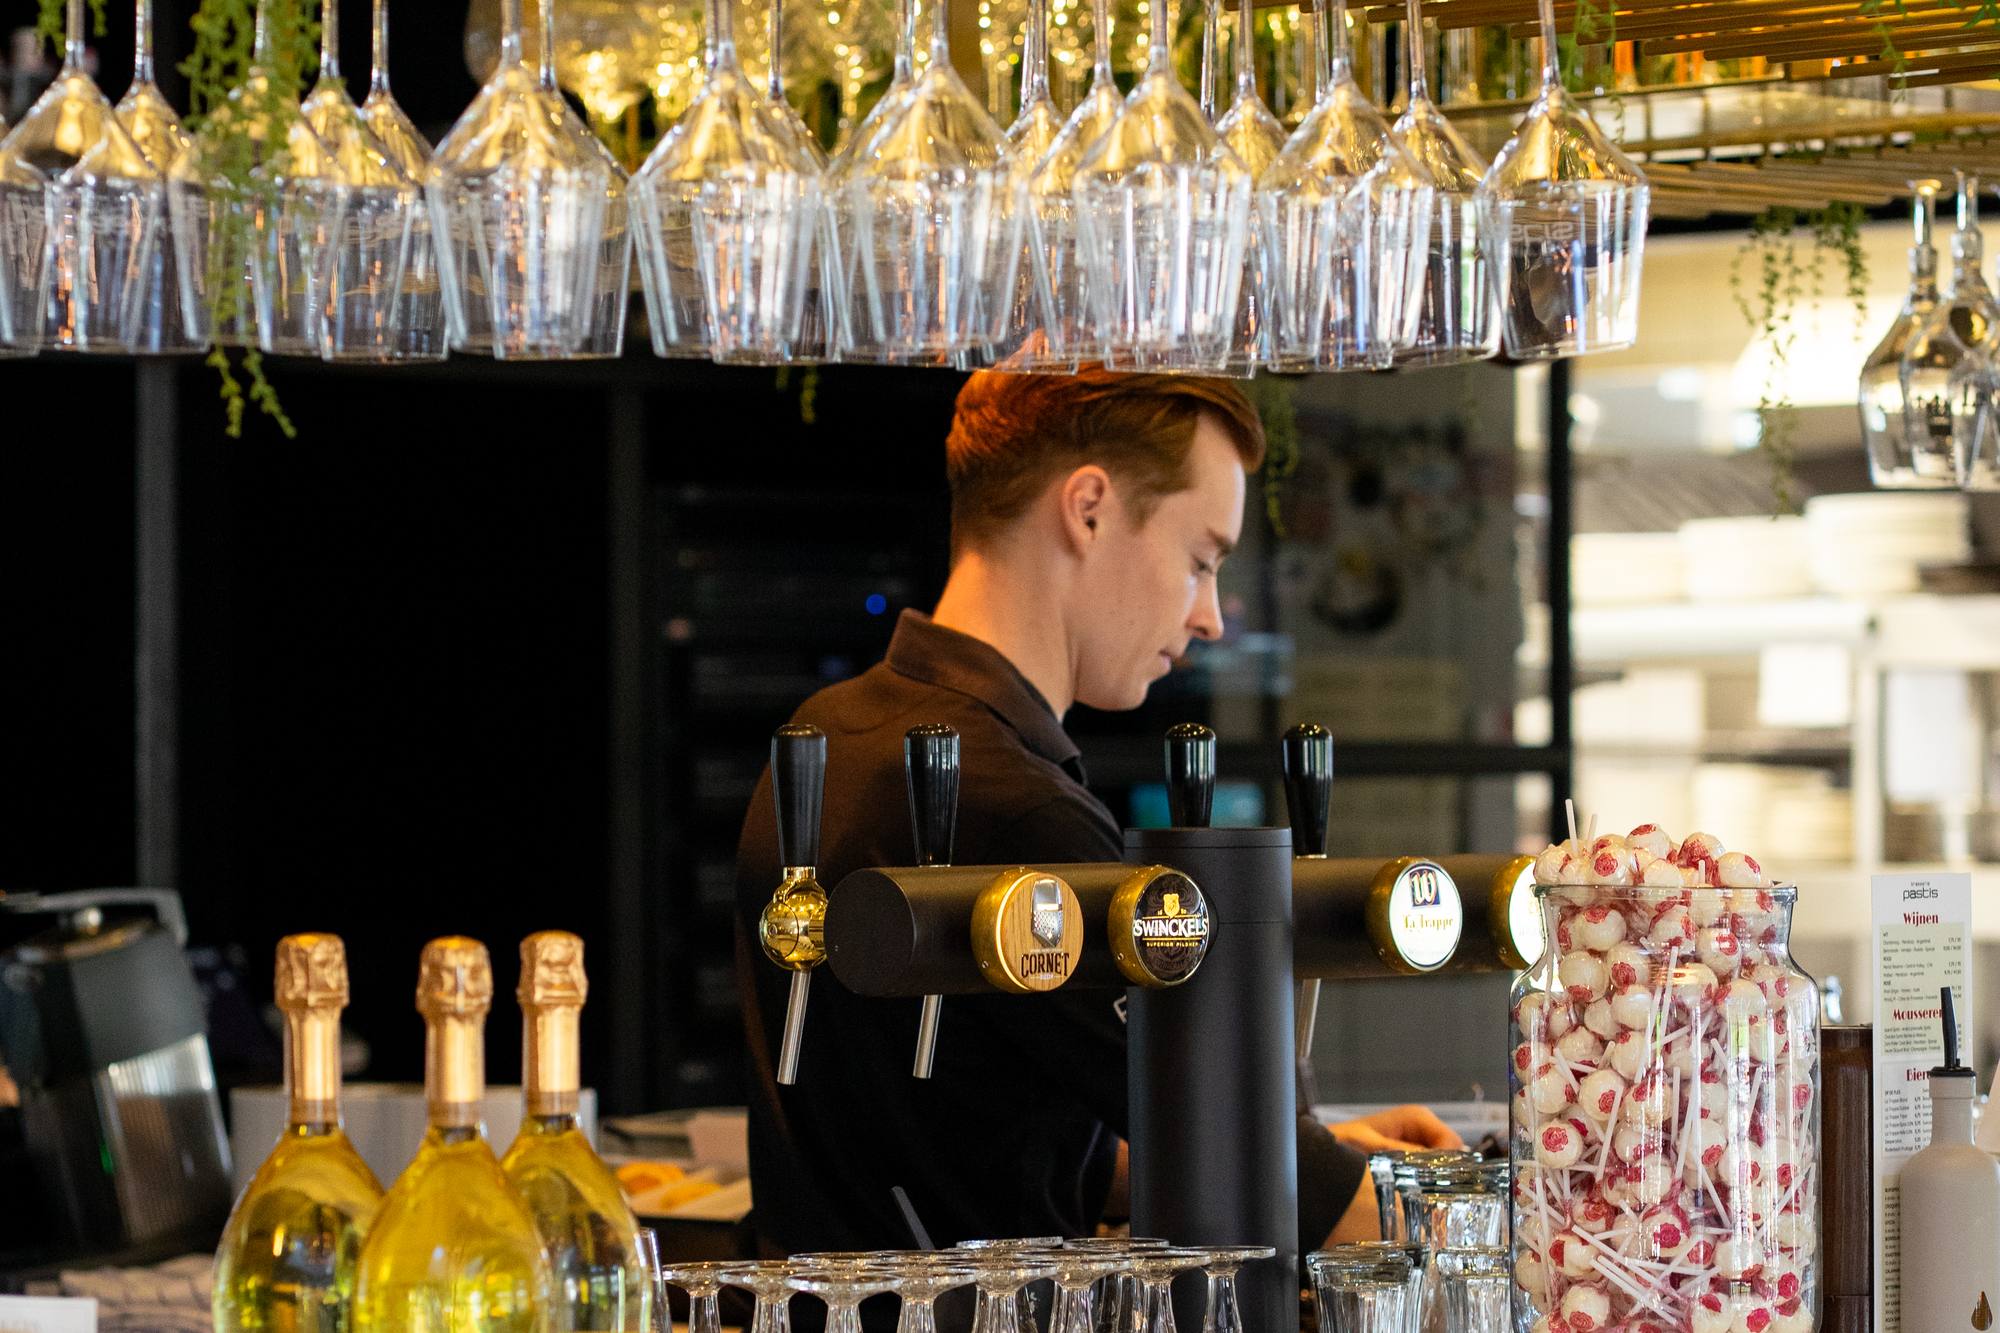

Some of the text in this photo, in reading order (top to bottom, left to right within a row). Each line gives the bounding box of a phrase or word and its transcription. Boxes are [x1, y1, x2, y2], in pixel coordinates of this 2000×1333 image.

[1902, 887, 1939, 902] pastis
[1133, 918, 1208, 938] SWINCKELS
[1903, 911, 1939, 927] Wijnen
[1021, 952, 1070, 978] CORNET
